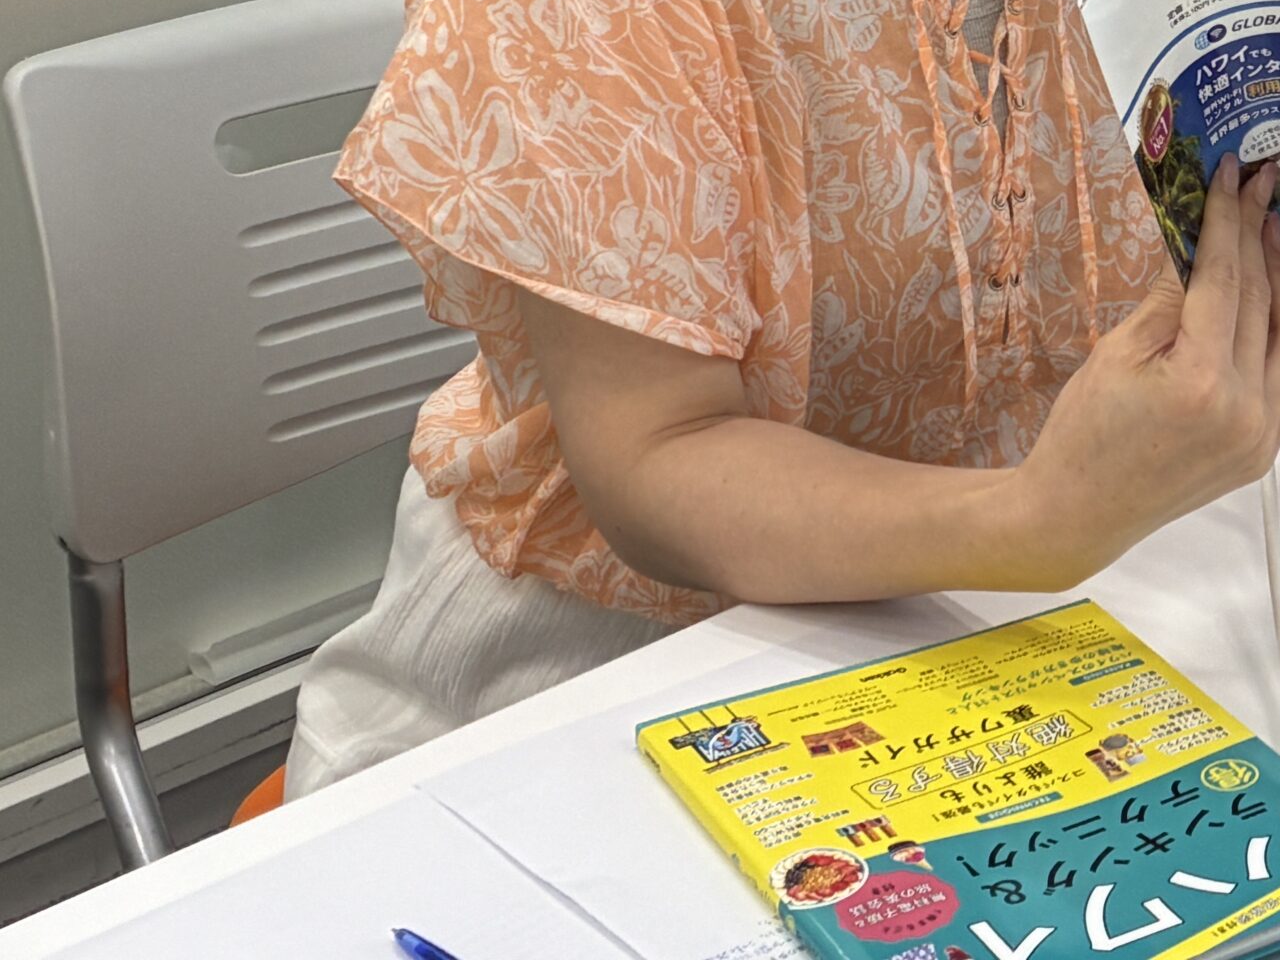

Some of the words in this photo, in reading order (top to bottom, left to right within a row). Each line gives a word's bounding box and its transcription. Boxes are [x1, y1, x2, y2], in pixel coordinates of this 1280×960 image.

[1195, 44, 1273, 87] ハワイでも
[1205, 97, 1243, 127] レンタル
[851, 703, 1040, 769] 裏ワザガイド
[862, 714, 1081, 804] 絶対得する
[929, 768, 1088, 822] コスパもタイパも最強！
[937, 760, 1055, 806] 誰よりも
[1198, 759, 1259, 790] 得
[953, 778, 1207, 878] テクニック！
[979, 790, 1274, 910] ランキング&
[847, 882, 933, 917] 旅の英会話
[852, 891, 946, 928] 無料電子版と
[968, 836, 1273, 960] ハワイ
